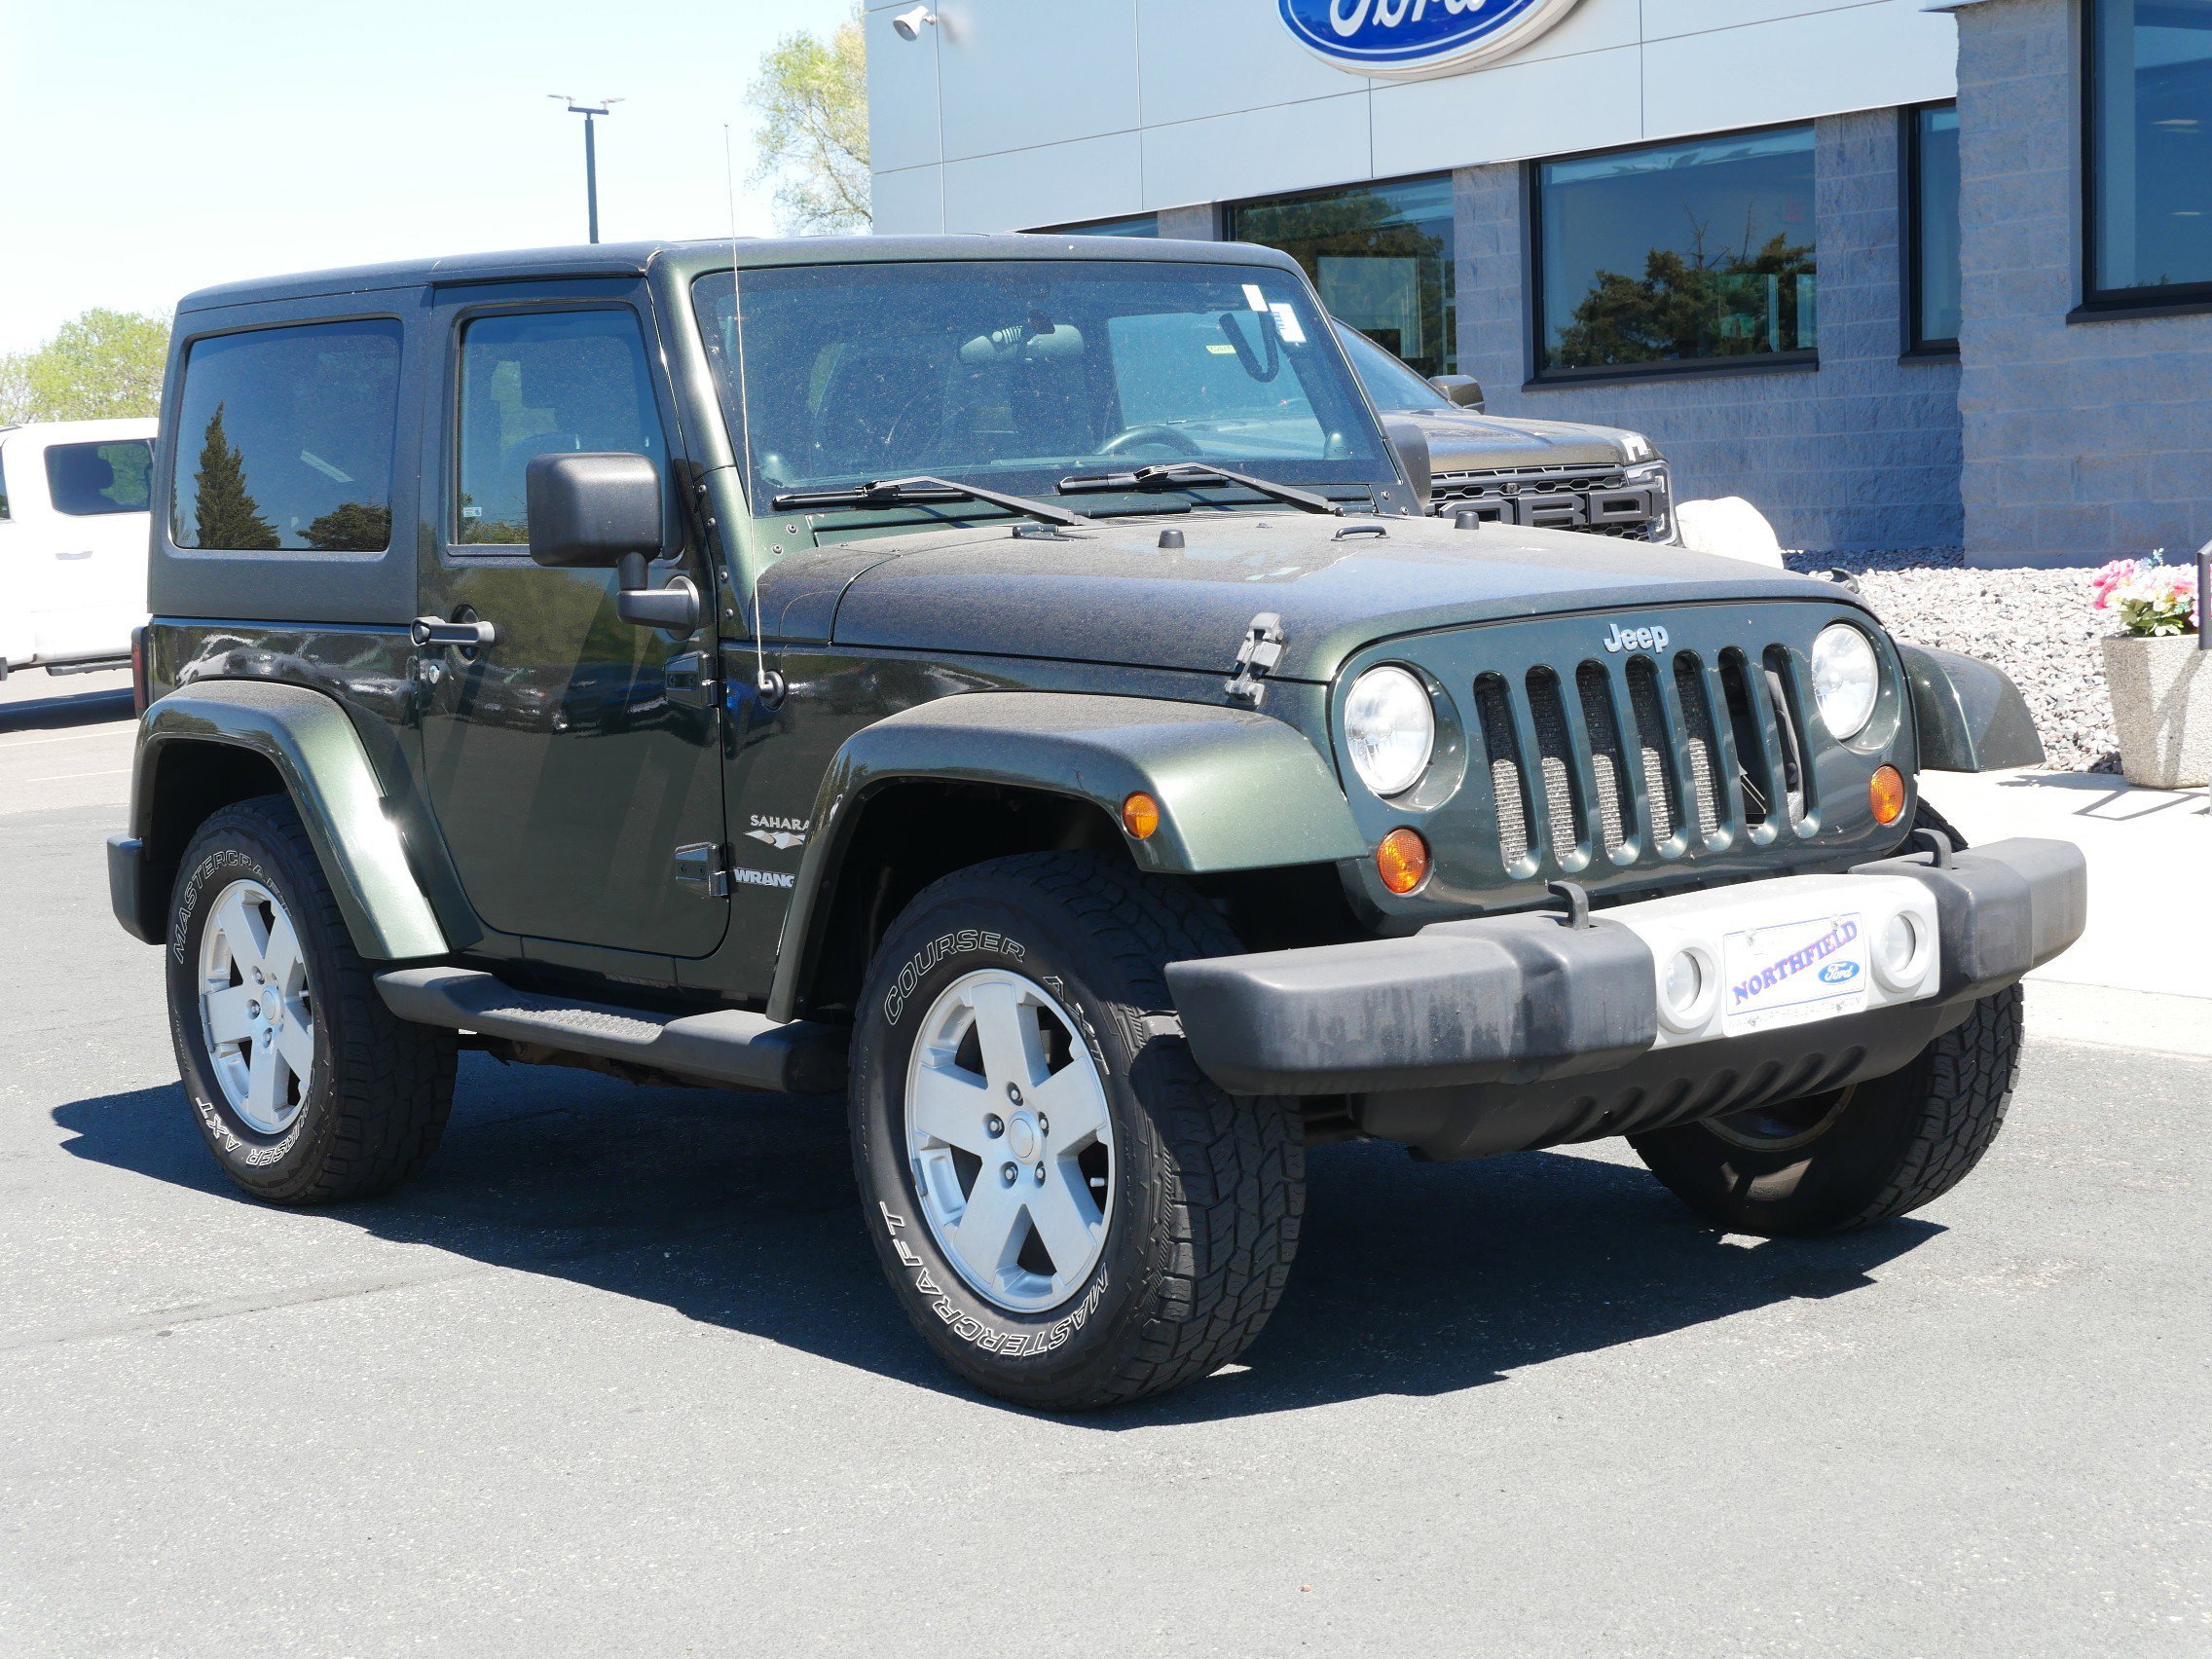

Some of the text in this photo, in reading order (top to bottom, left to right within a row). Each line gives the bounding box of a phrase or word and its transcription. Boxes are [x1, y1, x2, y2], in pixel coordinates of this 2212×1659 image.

[1434, 490, 1650, 529] ORD
[1604, 623, 1669, 653] Jeep
[750, 814, 810, 830] SAHARA
[172, 850, 292, 965] MASTERCRAFT
[884, 929, 1026, 1025] COURSER
[1732, 920, 1858, 1006] NORTHFIELD
[1824, 963, 1854, 981] Ford
[195, 1097, 242, 1152] AXT
[878, 1200, 1109, 1357] MASTERCRAFT
